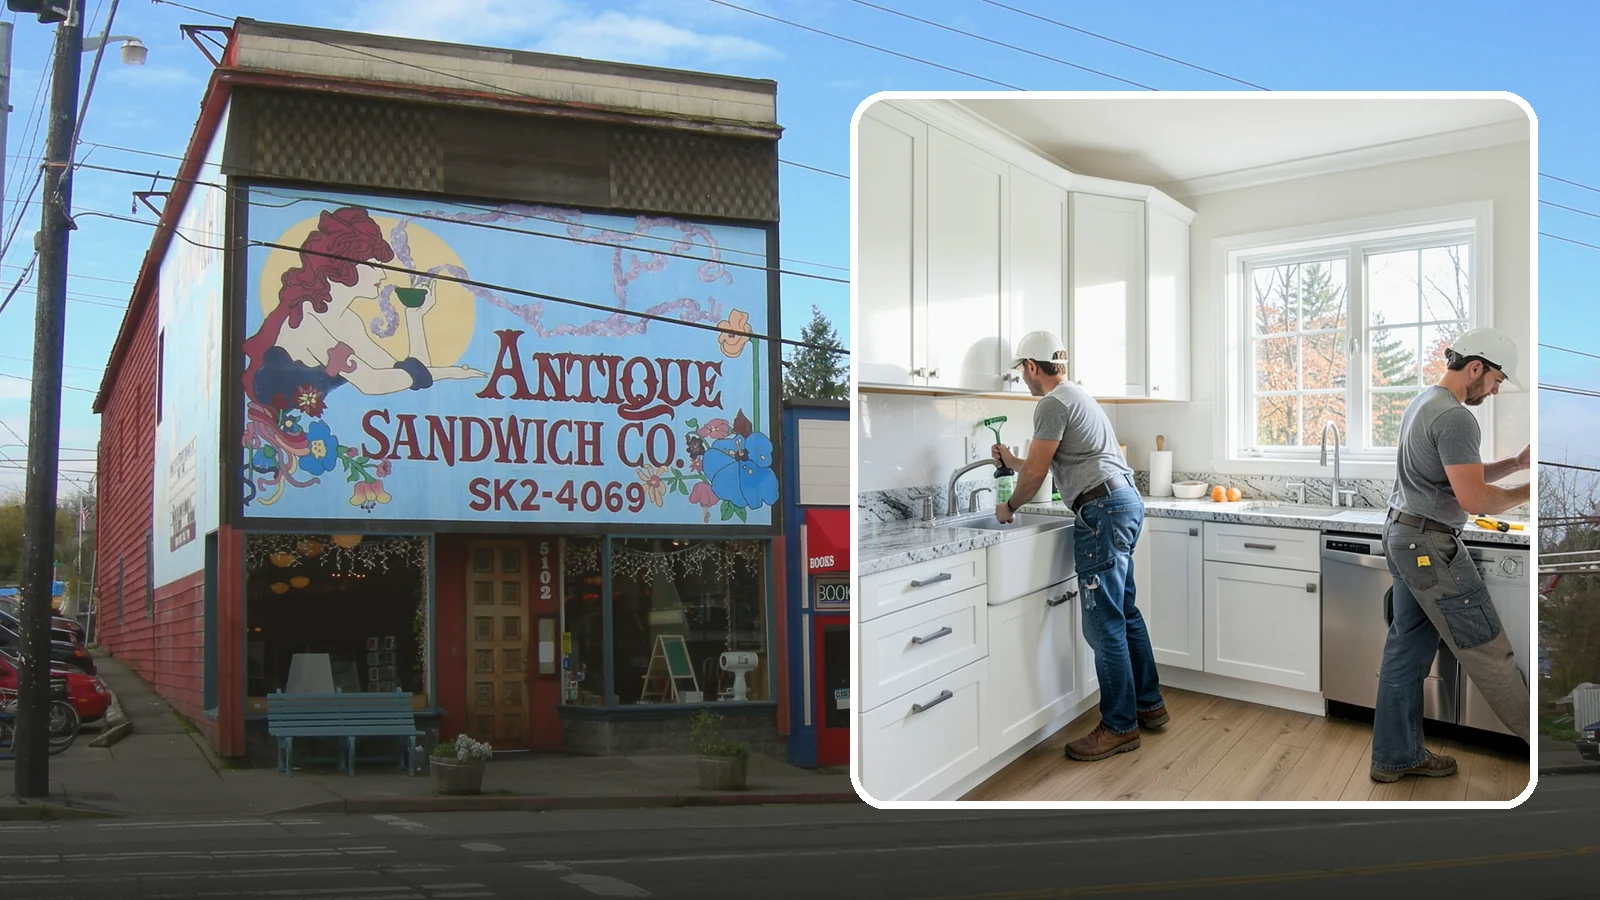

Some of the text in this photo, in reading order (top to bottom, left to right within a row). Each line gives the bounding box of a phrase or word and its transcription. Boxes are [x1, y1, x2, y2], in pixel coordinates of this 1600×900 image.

[476, 329, 724, 420] ANTIQUE
[361, 408, 685, 469] SANDWICH CO.
[468, 477, 645, 513] SK2-4069
[540, 541, 551, 600] 5102
[809, 555, 835, 569] BOOKS
